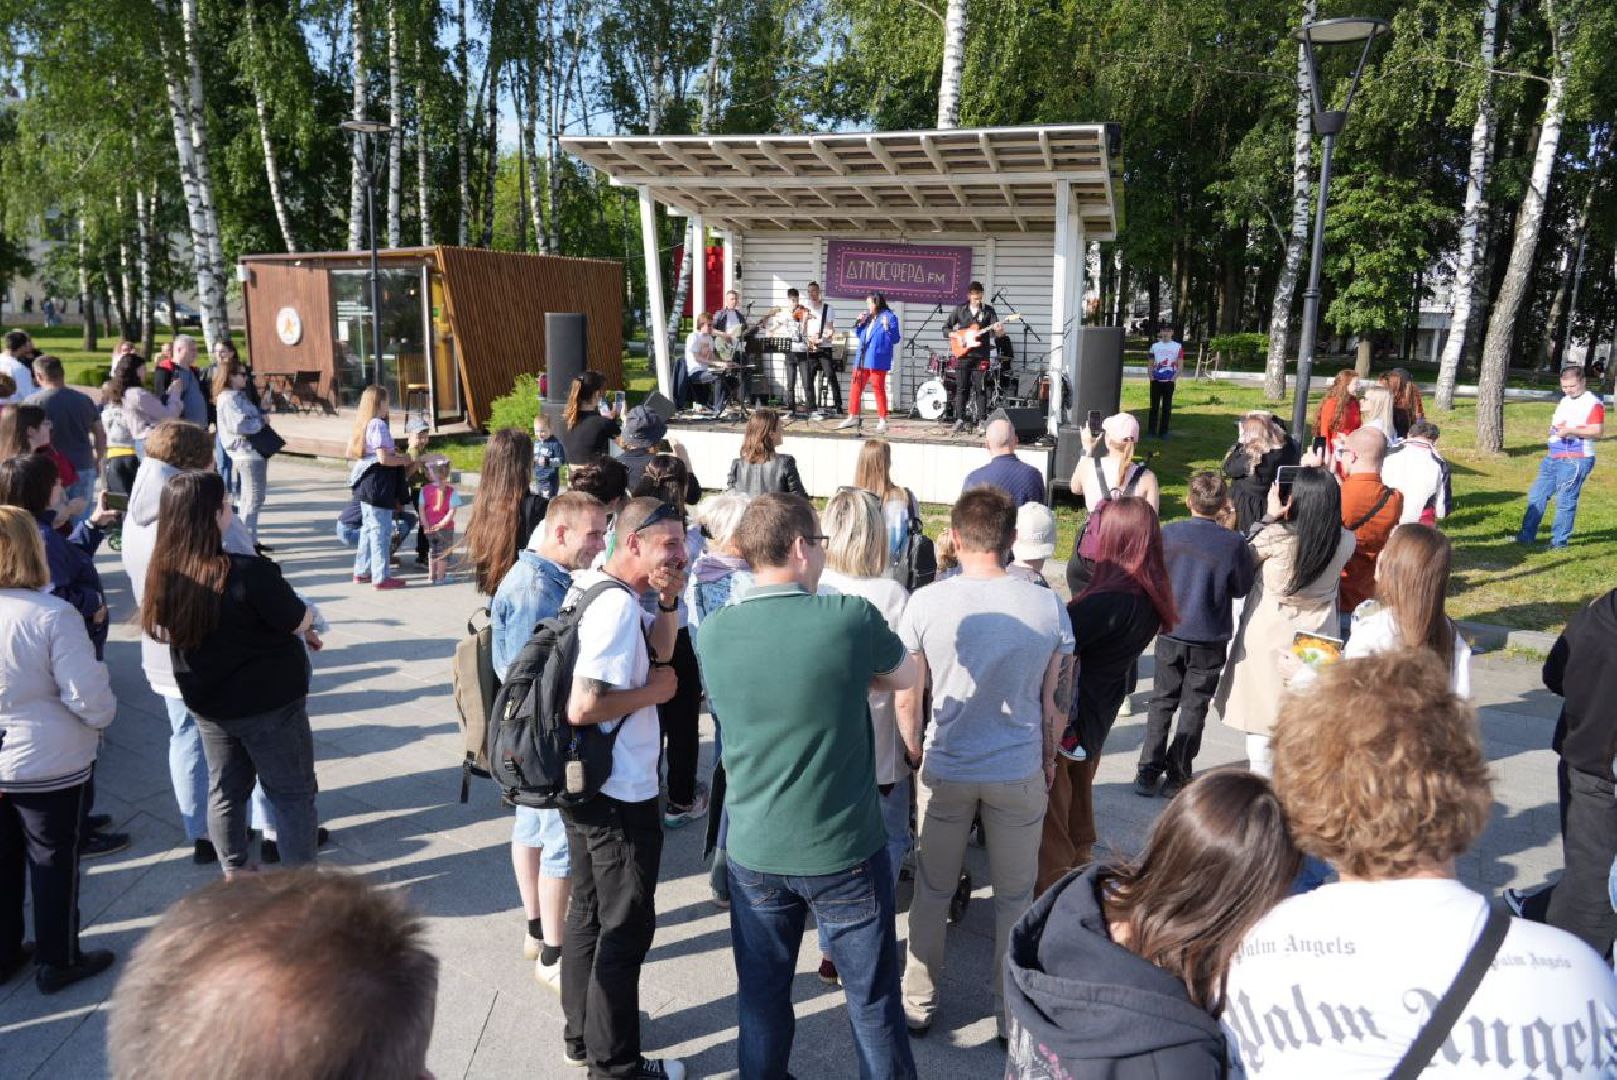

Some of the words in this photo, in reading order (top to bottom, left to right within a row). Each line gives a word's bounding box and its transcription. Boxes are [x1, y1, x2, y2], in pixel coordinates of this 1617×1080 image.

[927, 271, 945, 285] FM
[1284, 934, 1356, 957] Angels
[1225, 984, 1387, 1074] Palm
